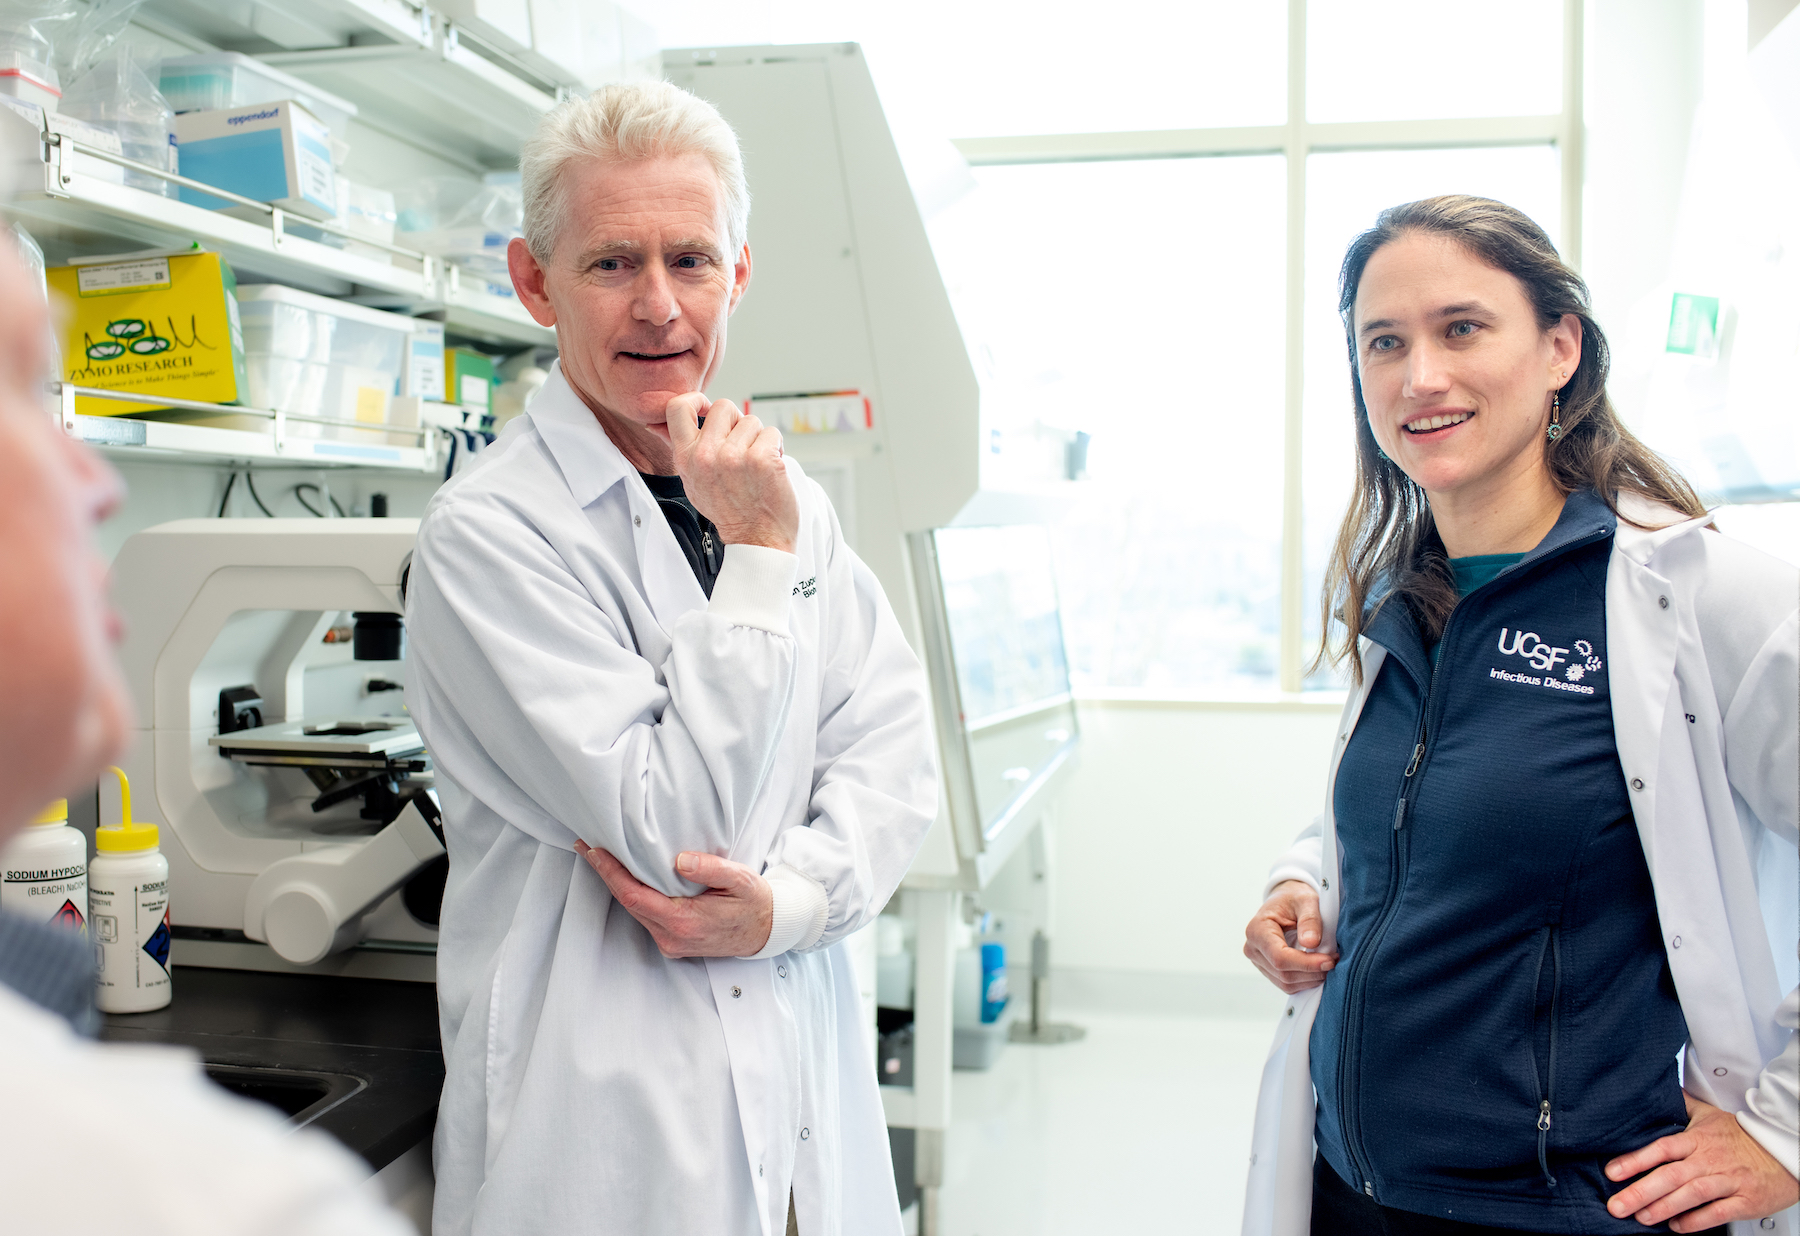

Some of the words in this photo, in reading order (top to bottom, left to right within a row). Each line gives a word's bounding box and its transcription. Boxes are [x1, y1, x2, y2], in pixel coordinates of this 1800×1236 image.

[227, 107, 279, 126] eppendorf
[68, 365, 112, 381] ZYMO
[116, 355, 193, 376] RESEARCH
[145, 375, 164, 384] Make
[167, 372, 190, 382] Things
[1498, 627, 1570, 671] UCSF
[1490, 668, 1541, 686] Infectious
[1543, 676, 1595, 695] Diseases
[7, 870, 48, 880] SODIUM
[28, 885, 65, 897] (BLEACH)
[156, 929, 168, 957] 2
